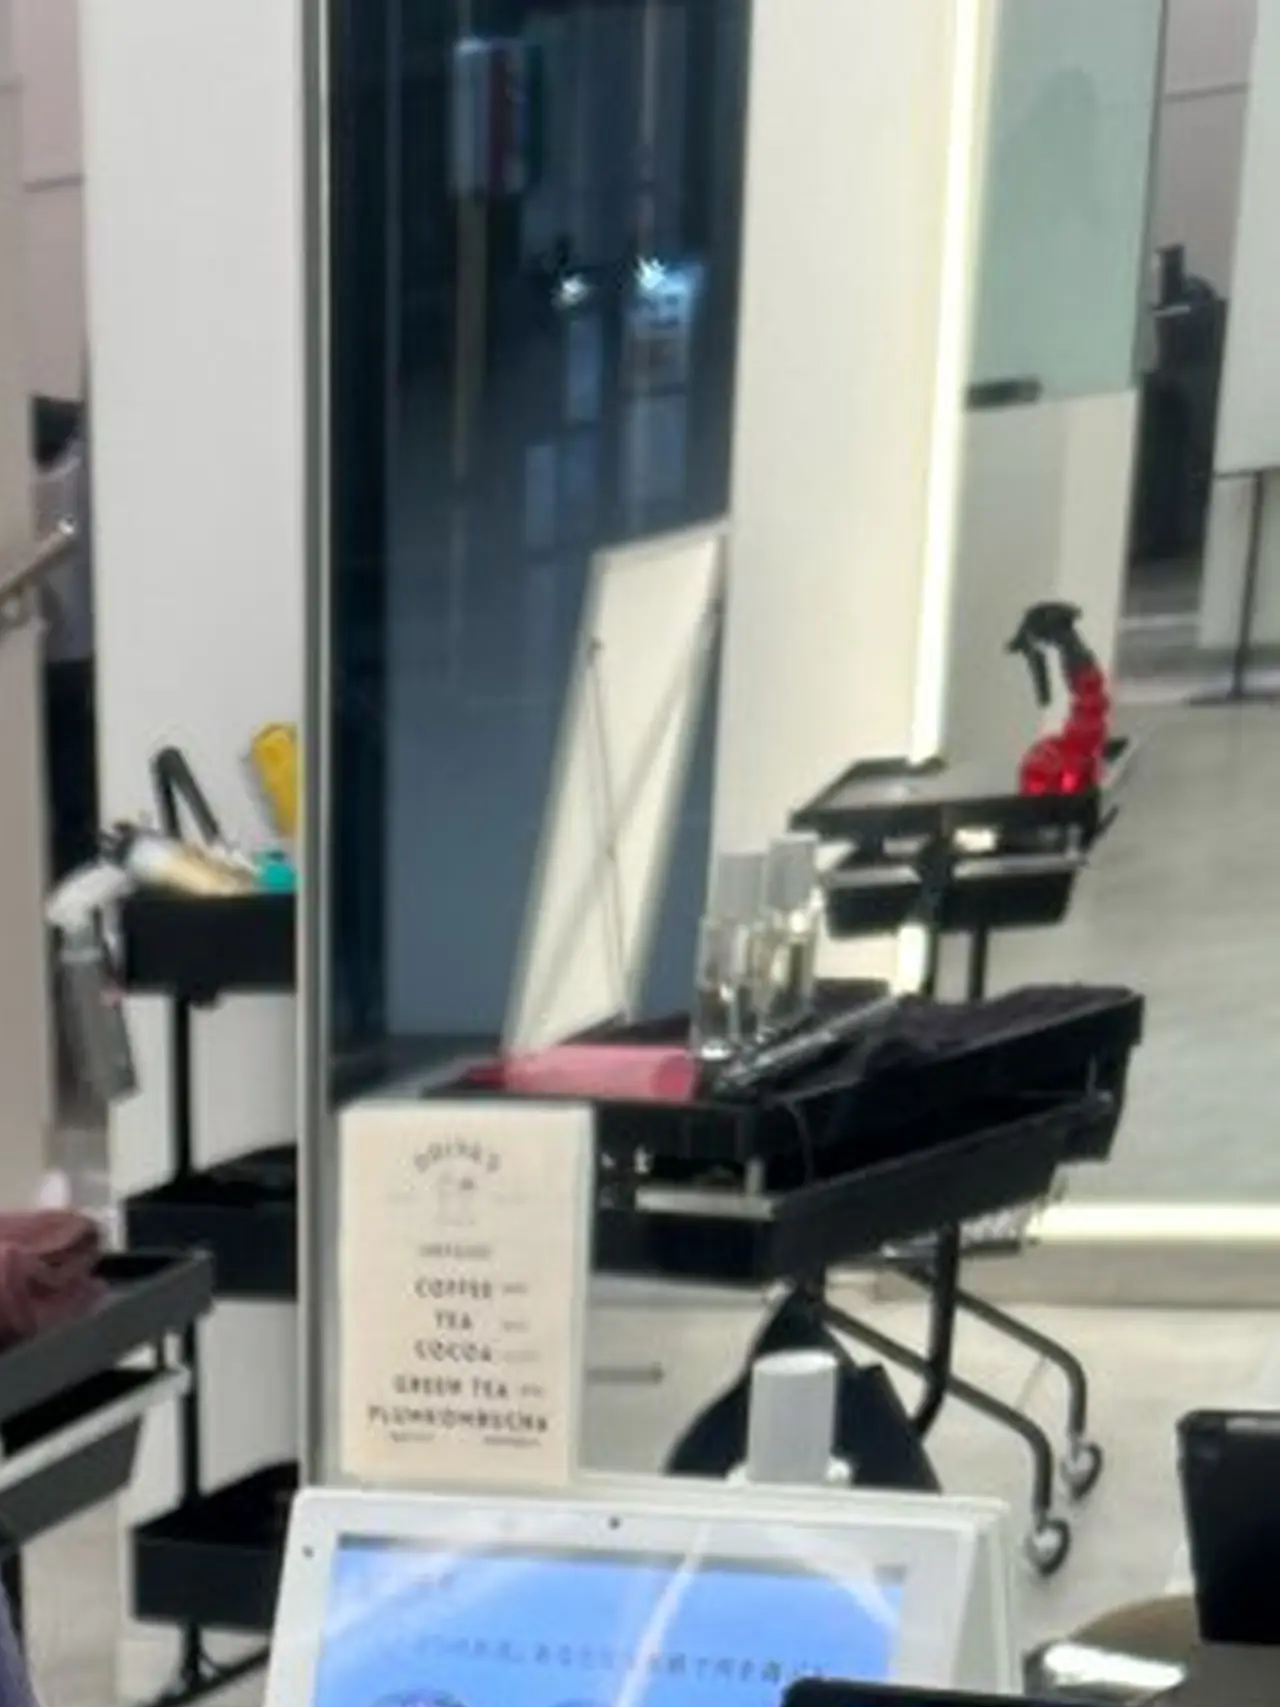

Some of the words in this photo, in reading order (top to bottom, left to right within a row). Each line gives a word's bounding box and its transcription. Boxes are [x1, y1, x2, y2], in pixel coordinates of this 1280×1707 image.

[413, 1277, 494, 1300] COFFEE
[434, 1308, 472, 1330] TEA
[413, 1338, 493, 1363] COCOA
[393, 1374, 463, 1396] GREEN
[472, 1375, 509, 1399] TEA
